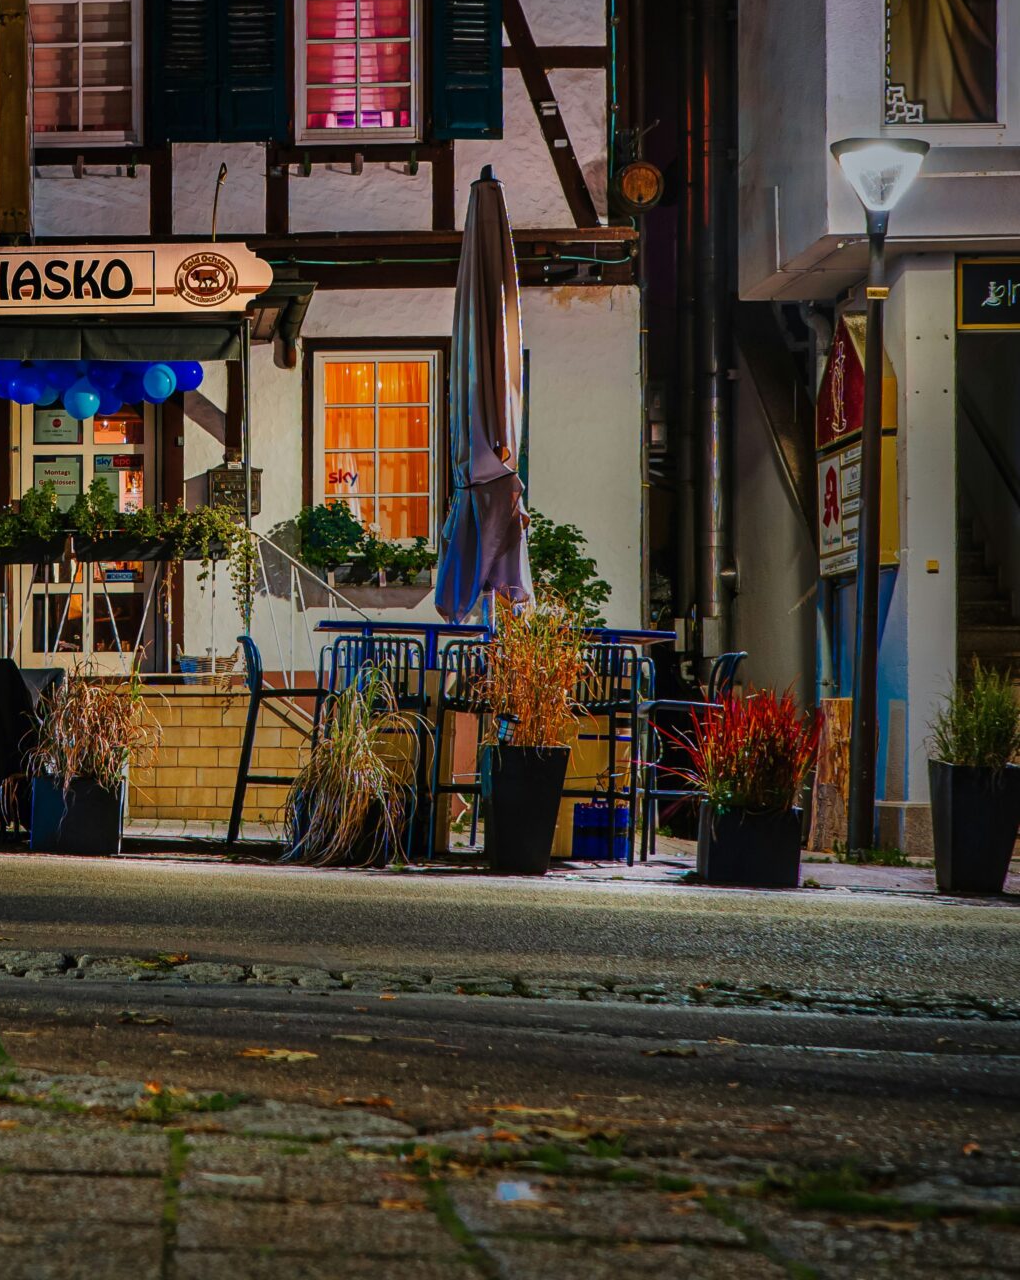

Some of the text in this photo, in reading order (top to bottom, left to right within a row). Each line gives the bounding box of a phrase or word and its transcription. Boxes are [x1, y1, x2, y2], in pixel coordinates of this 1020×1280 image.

[182, 255, 230, 271] Gold Ochsen
[97, 458, 111, 466] sky
[329, 468, 358, 486] sky
